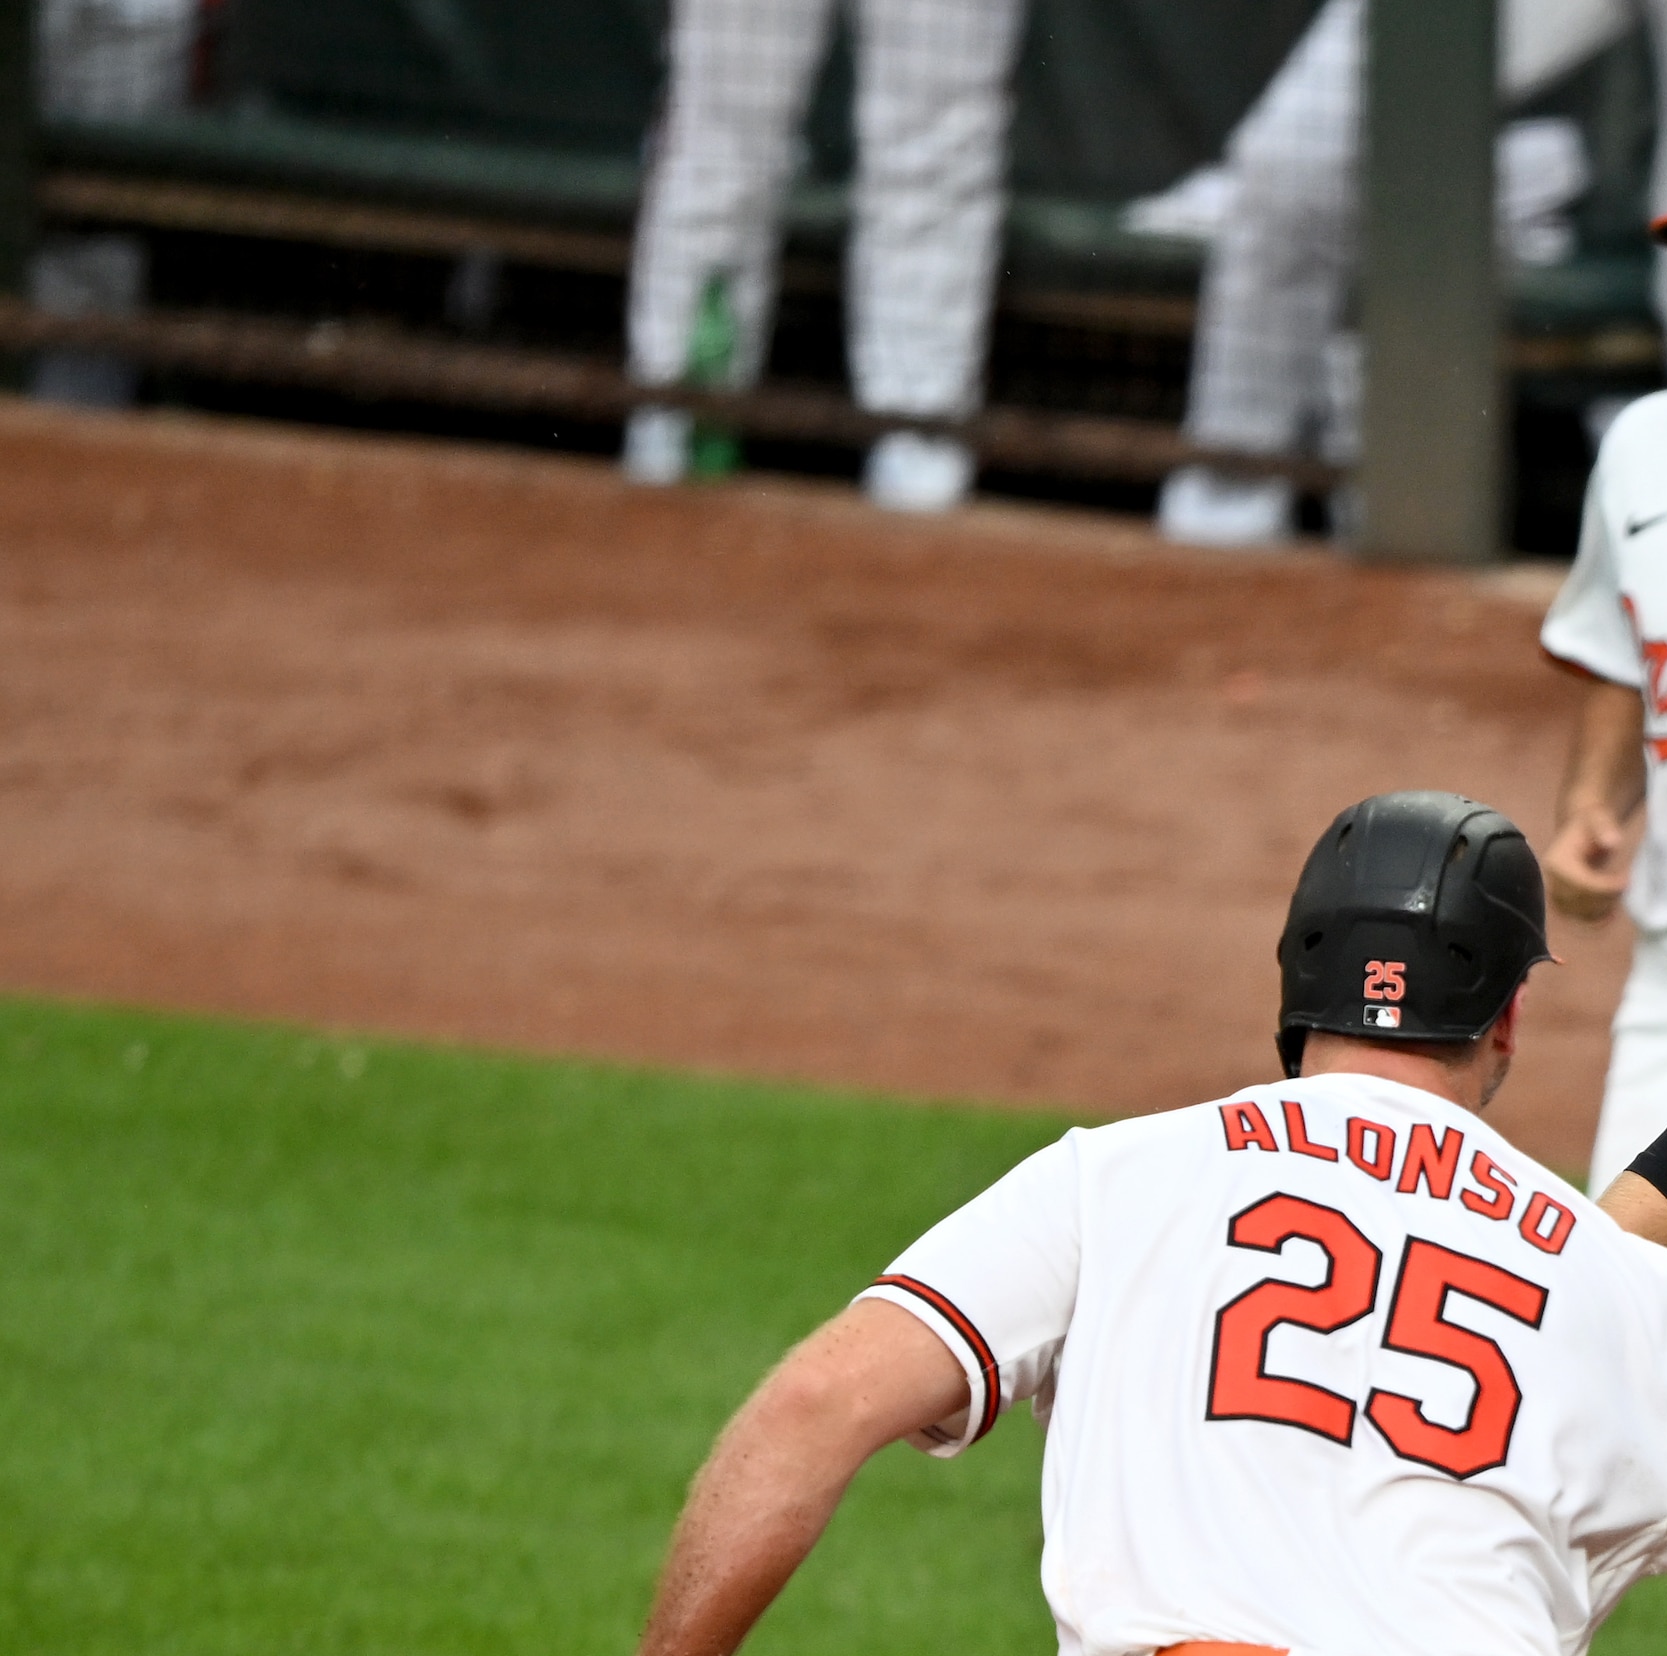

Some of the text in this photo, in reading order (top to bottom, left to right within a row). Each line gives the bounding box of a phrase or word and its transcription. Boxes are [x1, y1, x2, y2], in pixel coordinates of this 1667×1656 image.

[1364, 960, 1406, 1002] 25
[1218, 1101, 1577, 1255] ALONSO
[1206, 1191, 1549, 1480] 25
